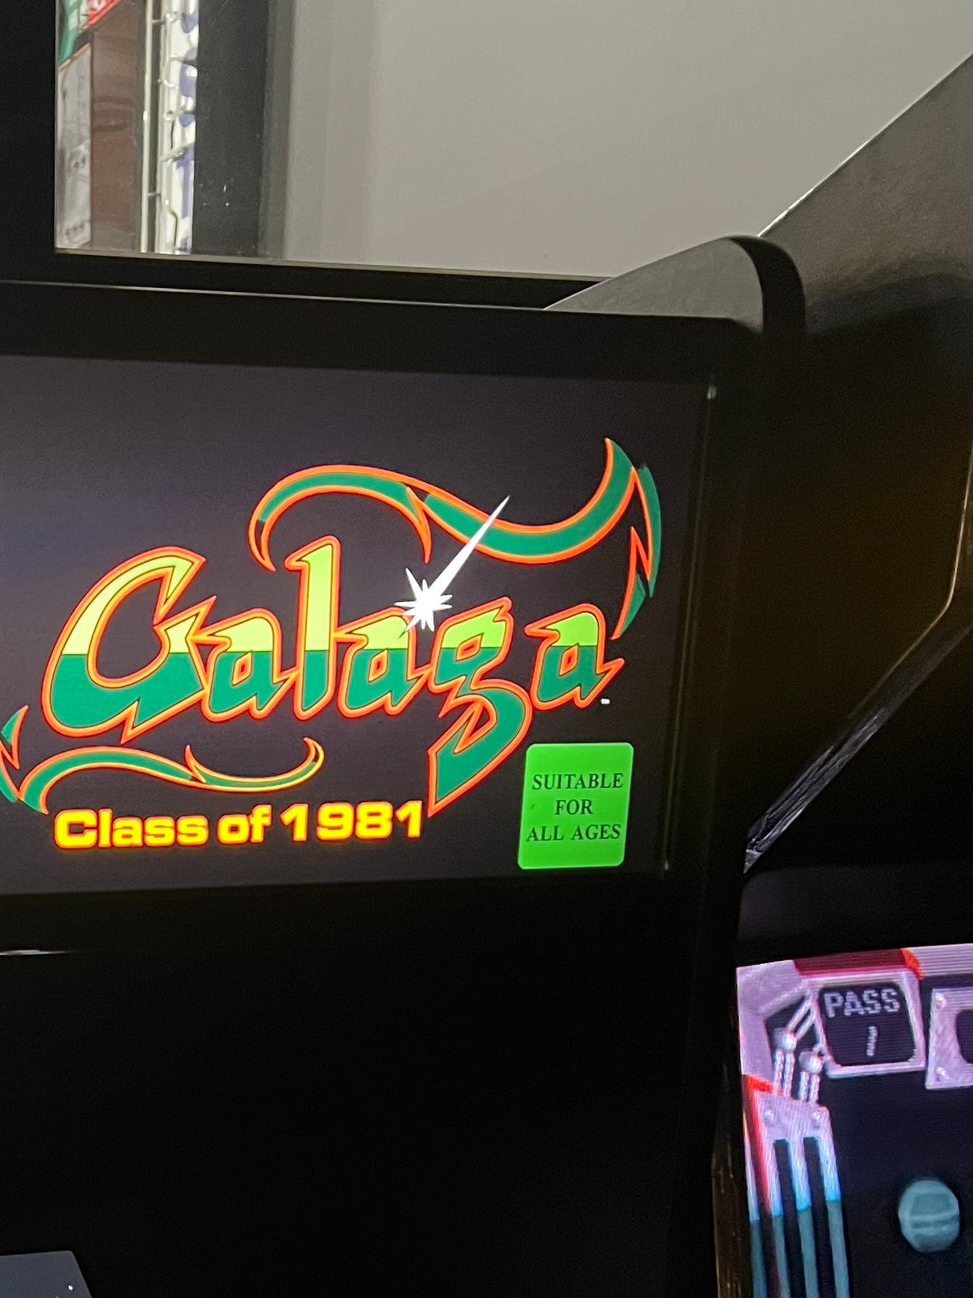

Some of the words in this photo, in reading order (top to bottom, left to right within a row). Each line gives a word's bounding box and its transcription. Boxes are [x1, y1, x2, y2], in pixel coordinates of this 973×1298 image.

[41, 535, 625, 818] Galaga
[532, 772, 624, 791] SUITABLE
[554, 798, 593, 816] FOR
[54, 808, 209, 850] Class
[218, 804, 272, 845] of
[280, 799, 424, 842] 1981
[526, 825, 565, 842] ALL
[570, 823, 622, 841] AGES
[823, 988, 901, 1018] PASS
